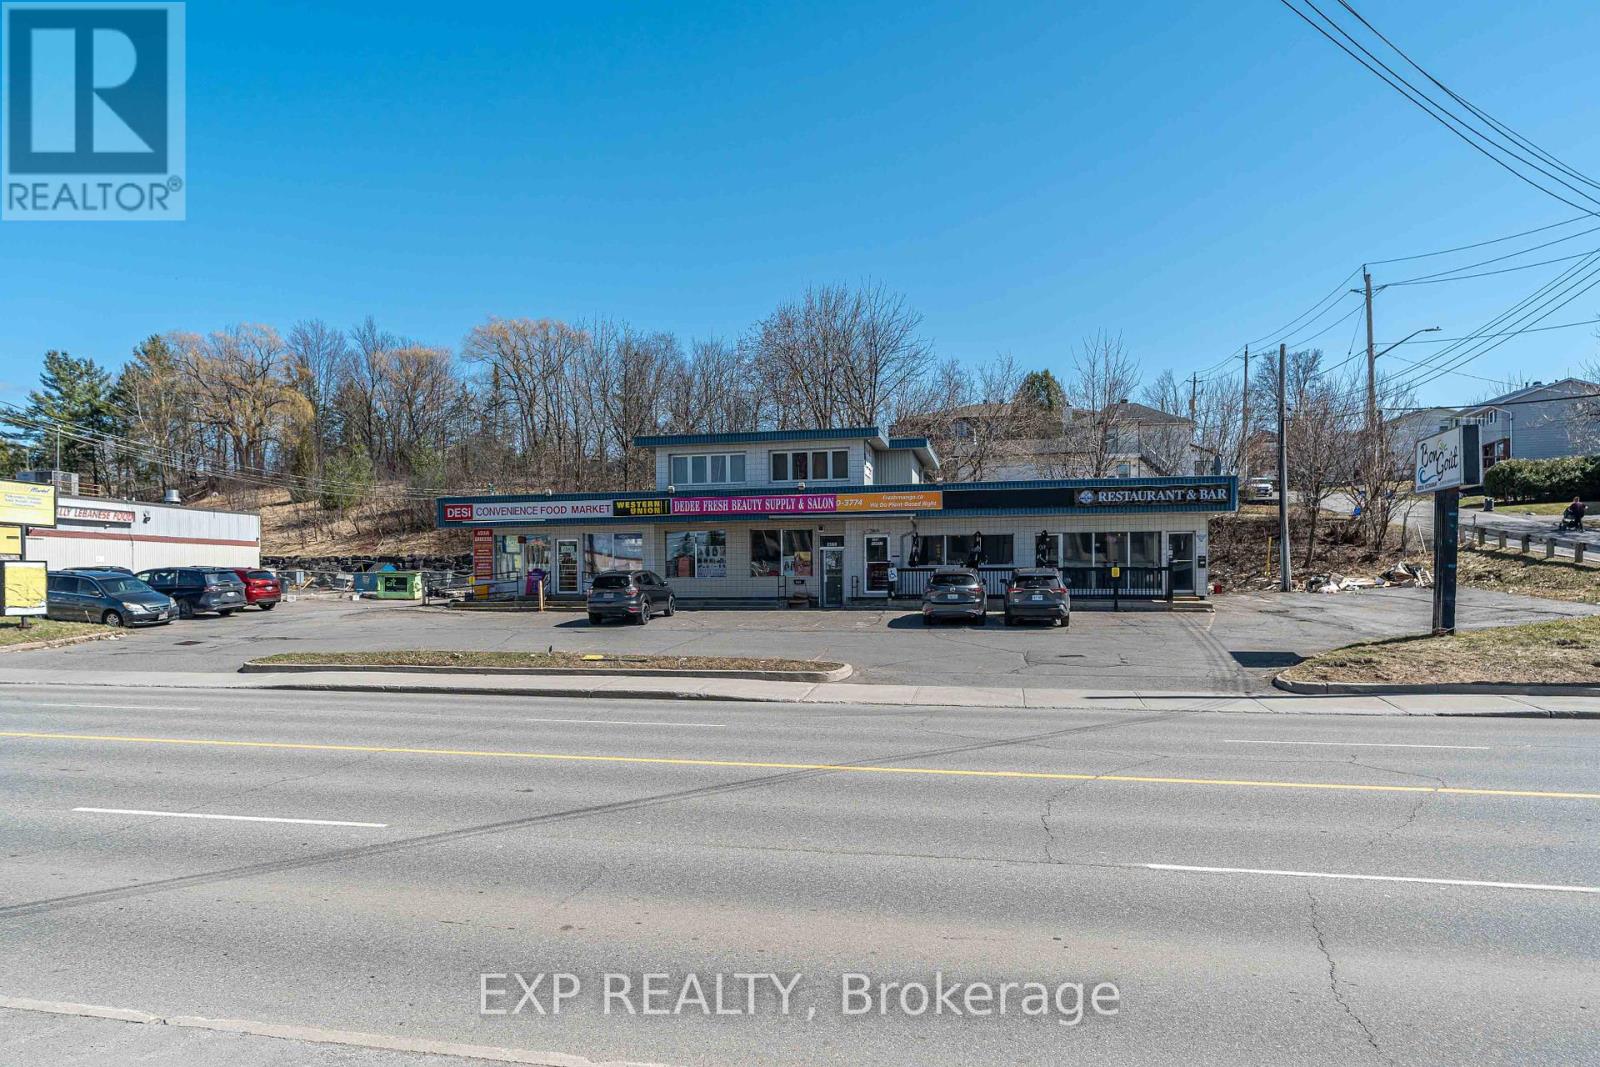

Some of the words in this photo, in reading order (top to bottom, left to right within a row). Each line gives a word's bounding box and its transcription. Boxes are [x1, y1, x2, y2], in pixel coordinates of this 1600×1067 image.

[1420, 442, 1438, 468] Bon
[1098, 489, 1184, 502] RESTAURANT
[1187, 489, 1196, 500] &
[1199, 488, 1227, 500] BAR
[476, 505, 538, 517] CONVENIENCE
[540, 505, 567, 515] FOOD
[571, 504, 611, 513] MARKET
[616, 500, 660, 509] WESTERN
[630, 507, 660, 515] UNION
[673, 500, 701, 512] DEDEE
[703, 499, 728, 511] FRESH
[731, 498, 762, 511] BEAUTY
[765, 497, 796, 510] SUPPLY
[798, 498, 805, 510] &
[807, 496, 834, 509] SALON
[74, 507, 111, 519] LEBANESE
[113, 511, 133, 521] FOOD
